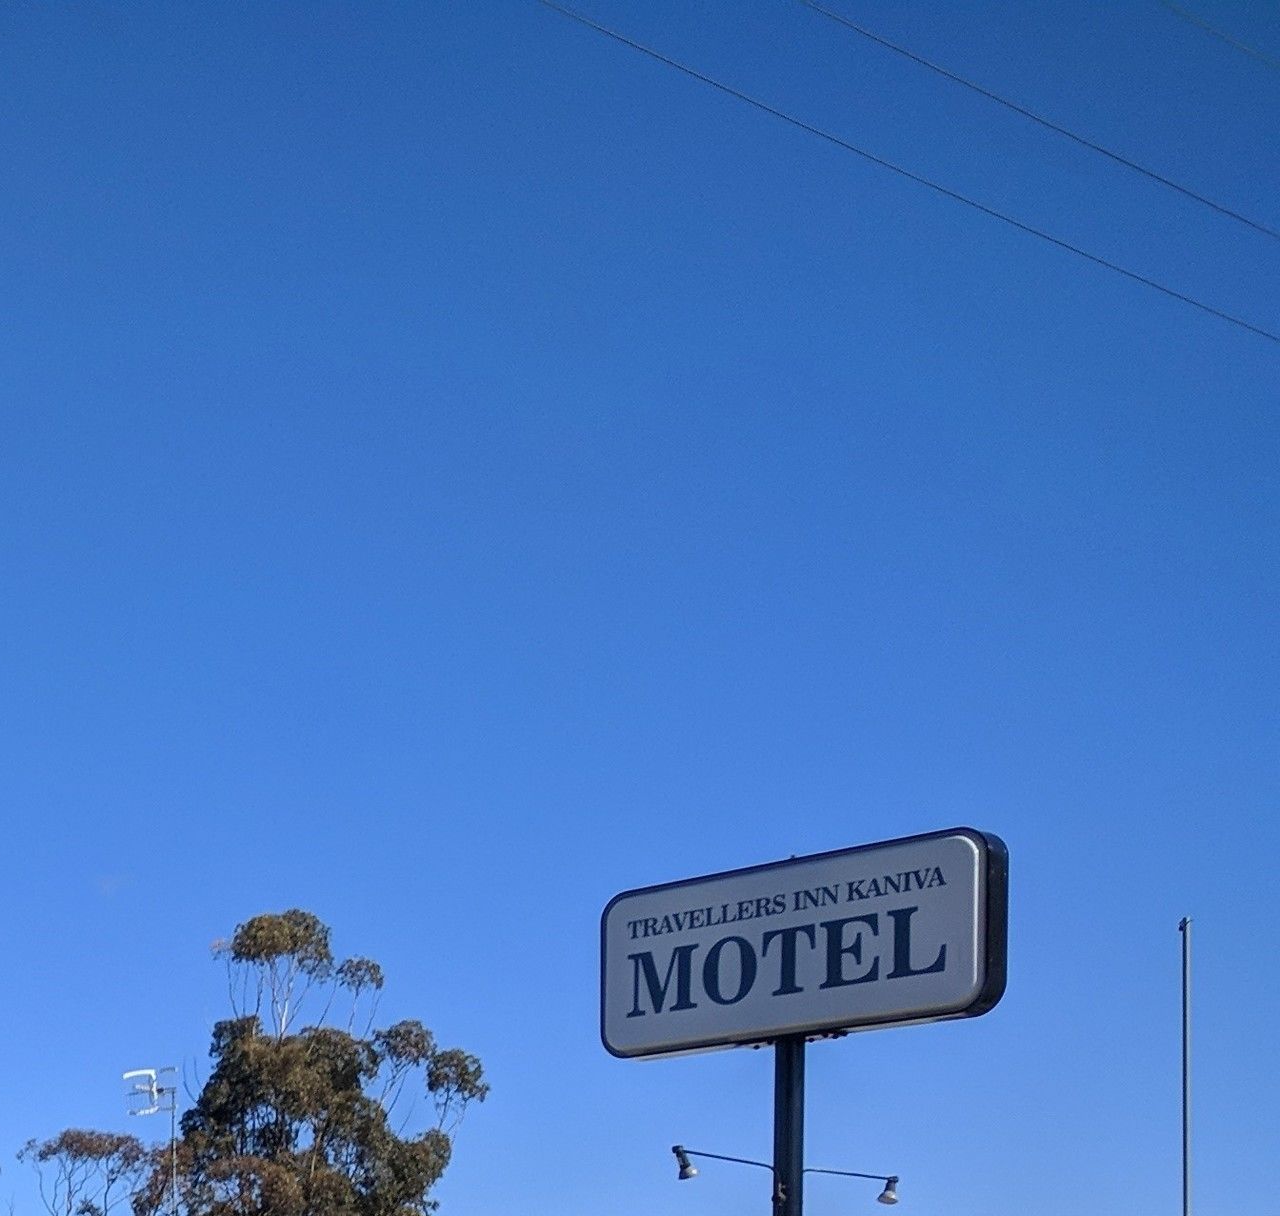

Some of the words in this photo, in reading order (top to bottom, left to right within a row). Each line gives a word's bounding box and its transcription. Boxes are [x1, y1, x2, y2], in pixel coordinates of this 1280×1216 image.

[628, 893, 787, 940] TRAVELLERS
[792, 884, 841, 912] INN
[845, 866, 947, 901] KANIVA
[627, 906, 947, 1018] MOTEL
